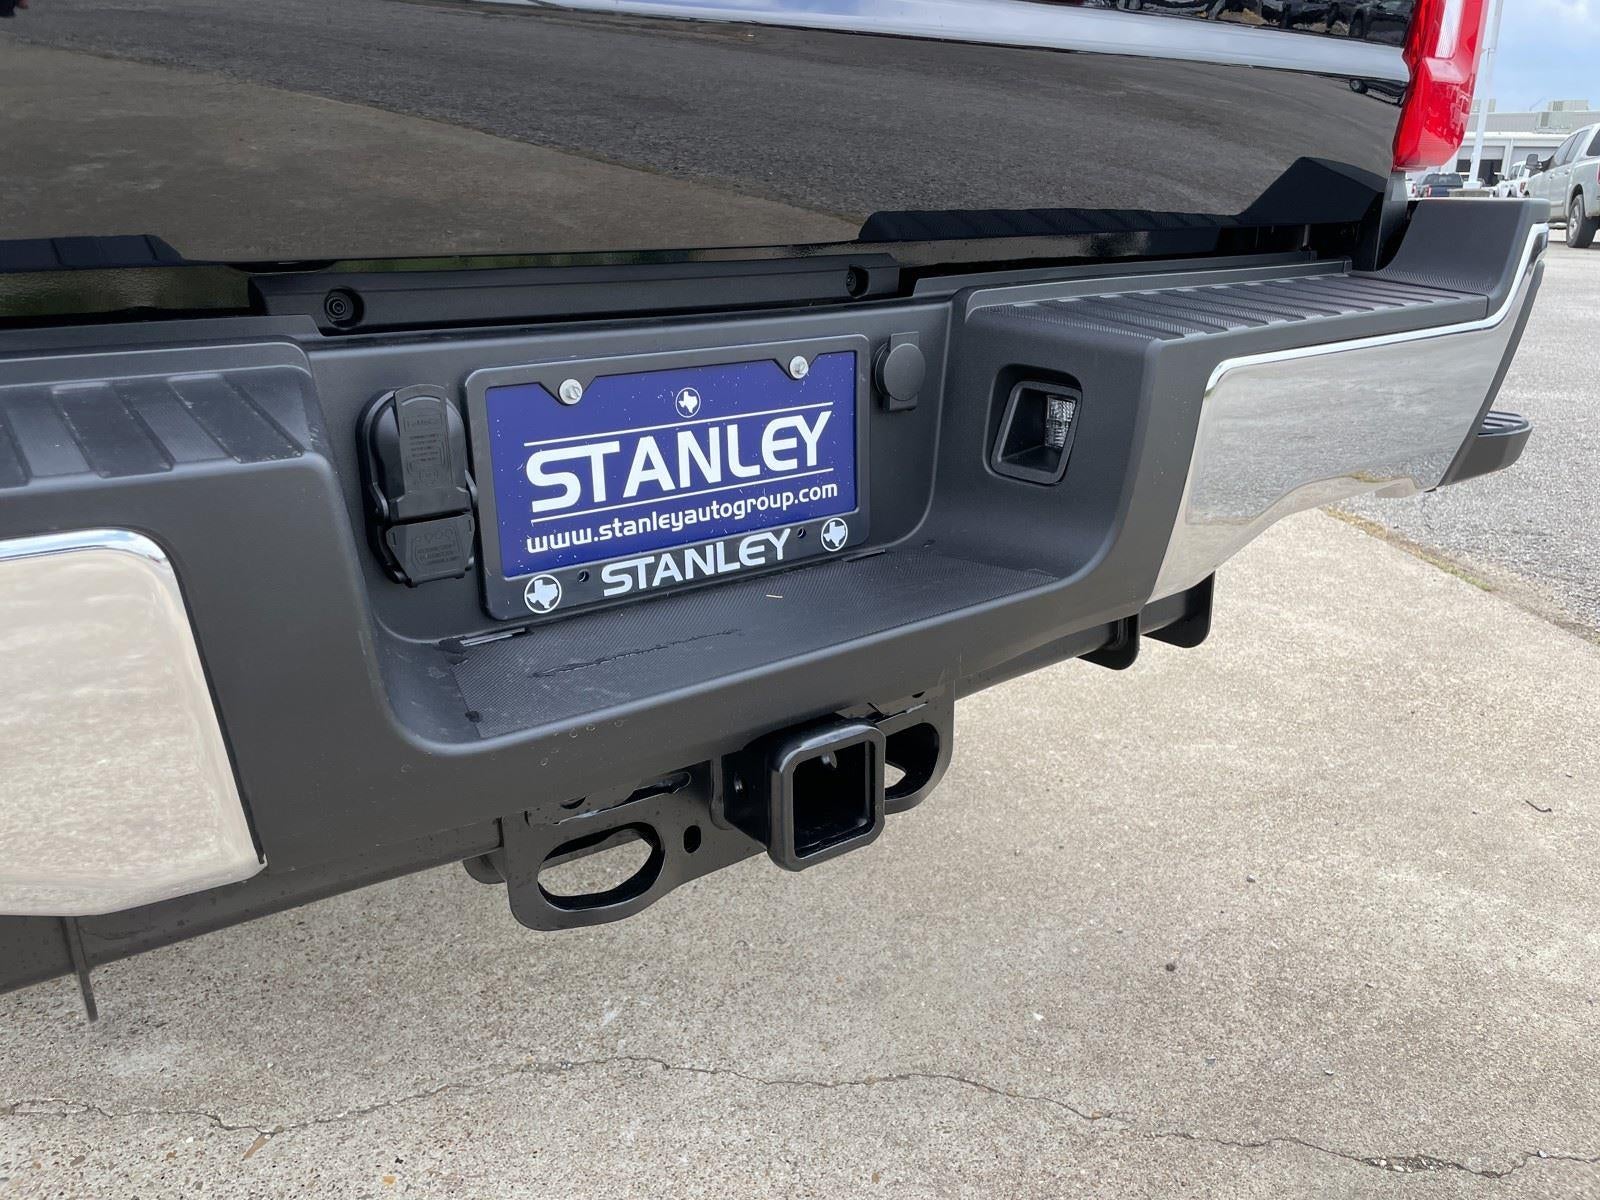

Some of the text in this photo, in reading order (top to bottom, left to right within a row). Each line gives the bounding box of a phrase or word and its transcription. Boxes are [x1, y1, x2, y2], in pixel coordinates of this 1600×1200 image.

[525, 410, 833, 513] STANLEY
[526, 483, 838, 554] www.stanleyautogroup.com
[601, 528, 791, 597] STANLEY
